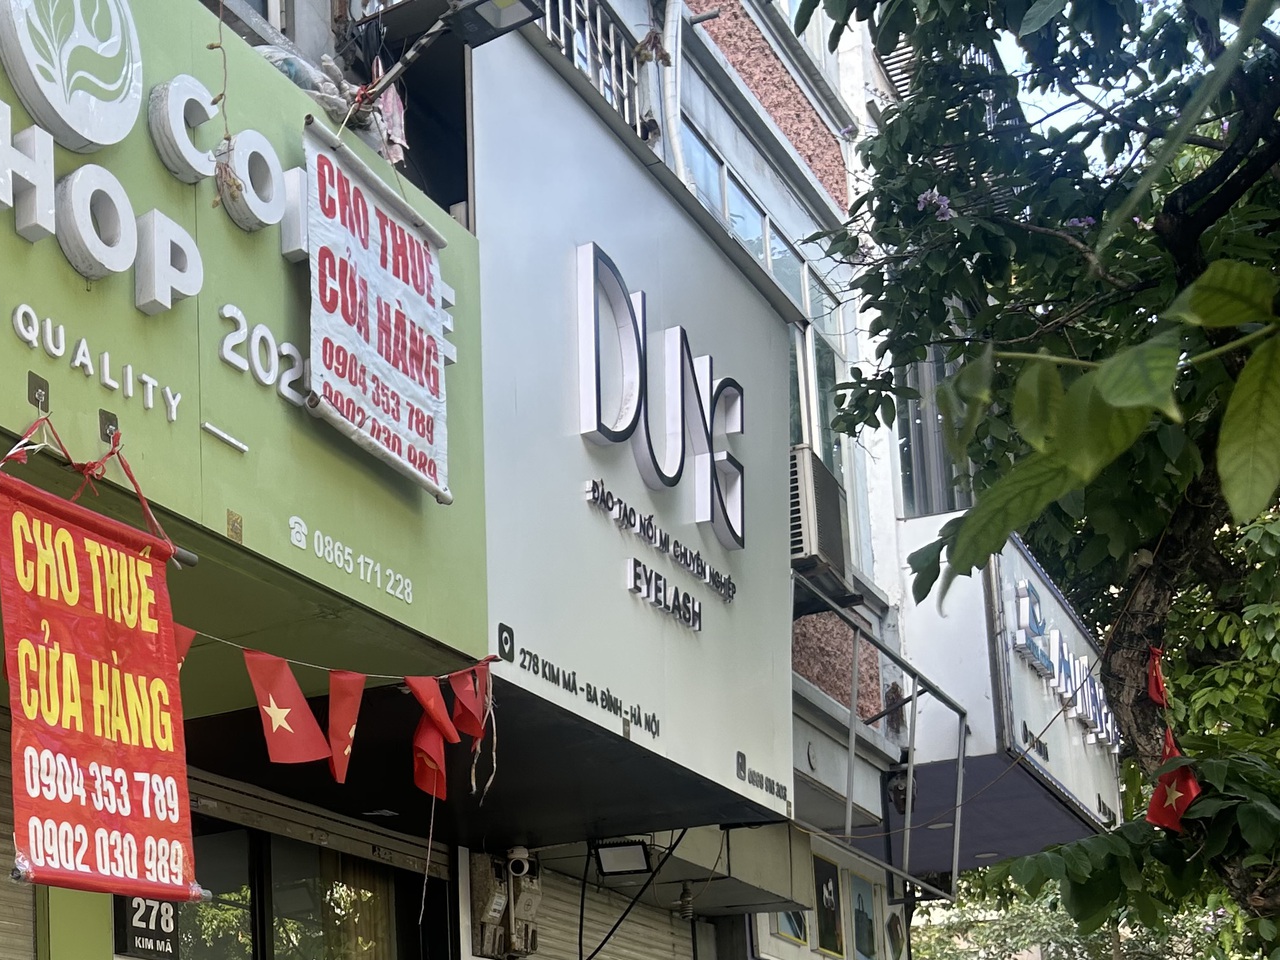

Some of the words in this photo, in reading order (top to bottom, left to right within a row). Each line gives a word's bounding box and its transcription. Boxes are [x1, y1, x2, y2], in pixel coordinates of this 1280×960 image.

[317, 153, 370, 251] CHO
[374, 205, 436, 309] THUÊ
[12, 303, 183, 422] QUALITY
[220, 303, 312, 408] 202
[318, 245, 371, 345] CỬA
[377, 294, 440, 399] HÀNG
[322, 336, 368, 396] 0904
[371, 374, 401, 422] 353
[405, 400, 434, 446] 789
[11, 510, 80, 607] CHO
[83, 537, 159, 634] THUÊ
[313, 530, 354, 574] 0865
[356, 554, 382, 588] 171
[385, 568, 413, 604] 228
[586, 478, 614, 511] ĐÀO
[637, 514, 657, 544] NỐI
[657, 529, 670, 553] MI
[672, 540, 707, 579] CHUYÊN
[628, 557, 702, 632] EYELASH
[17, 618, 84, 733] CỬA
[91, 650, 174, 752] HÀNG
[519, 648, 540, 675] 278
[541, 658, 560, 687] KIM
[562, 669, 578, 696] MÃ
[586, 682, 599, 706] BA
[600, 687, 623, 718] ĐÌNH
[630, 704, 643, 728] HÀ
[644, 712, 660, 739] NỘI
[23, 745, 87, 806] 0904
[88, 761, 131, 817] 353
[133, 772, 180, 824] 789
[28, 815, 93, 874] 0902
[94, 827, 138, 880] 030
[144, 835, 184, 887] 989
[131, 897, 174, 933] 278
[135, 936, 154, 950] KIM
[156, 938, 173, 953] MÃ
